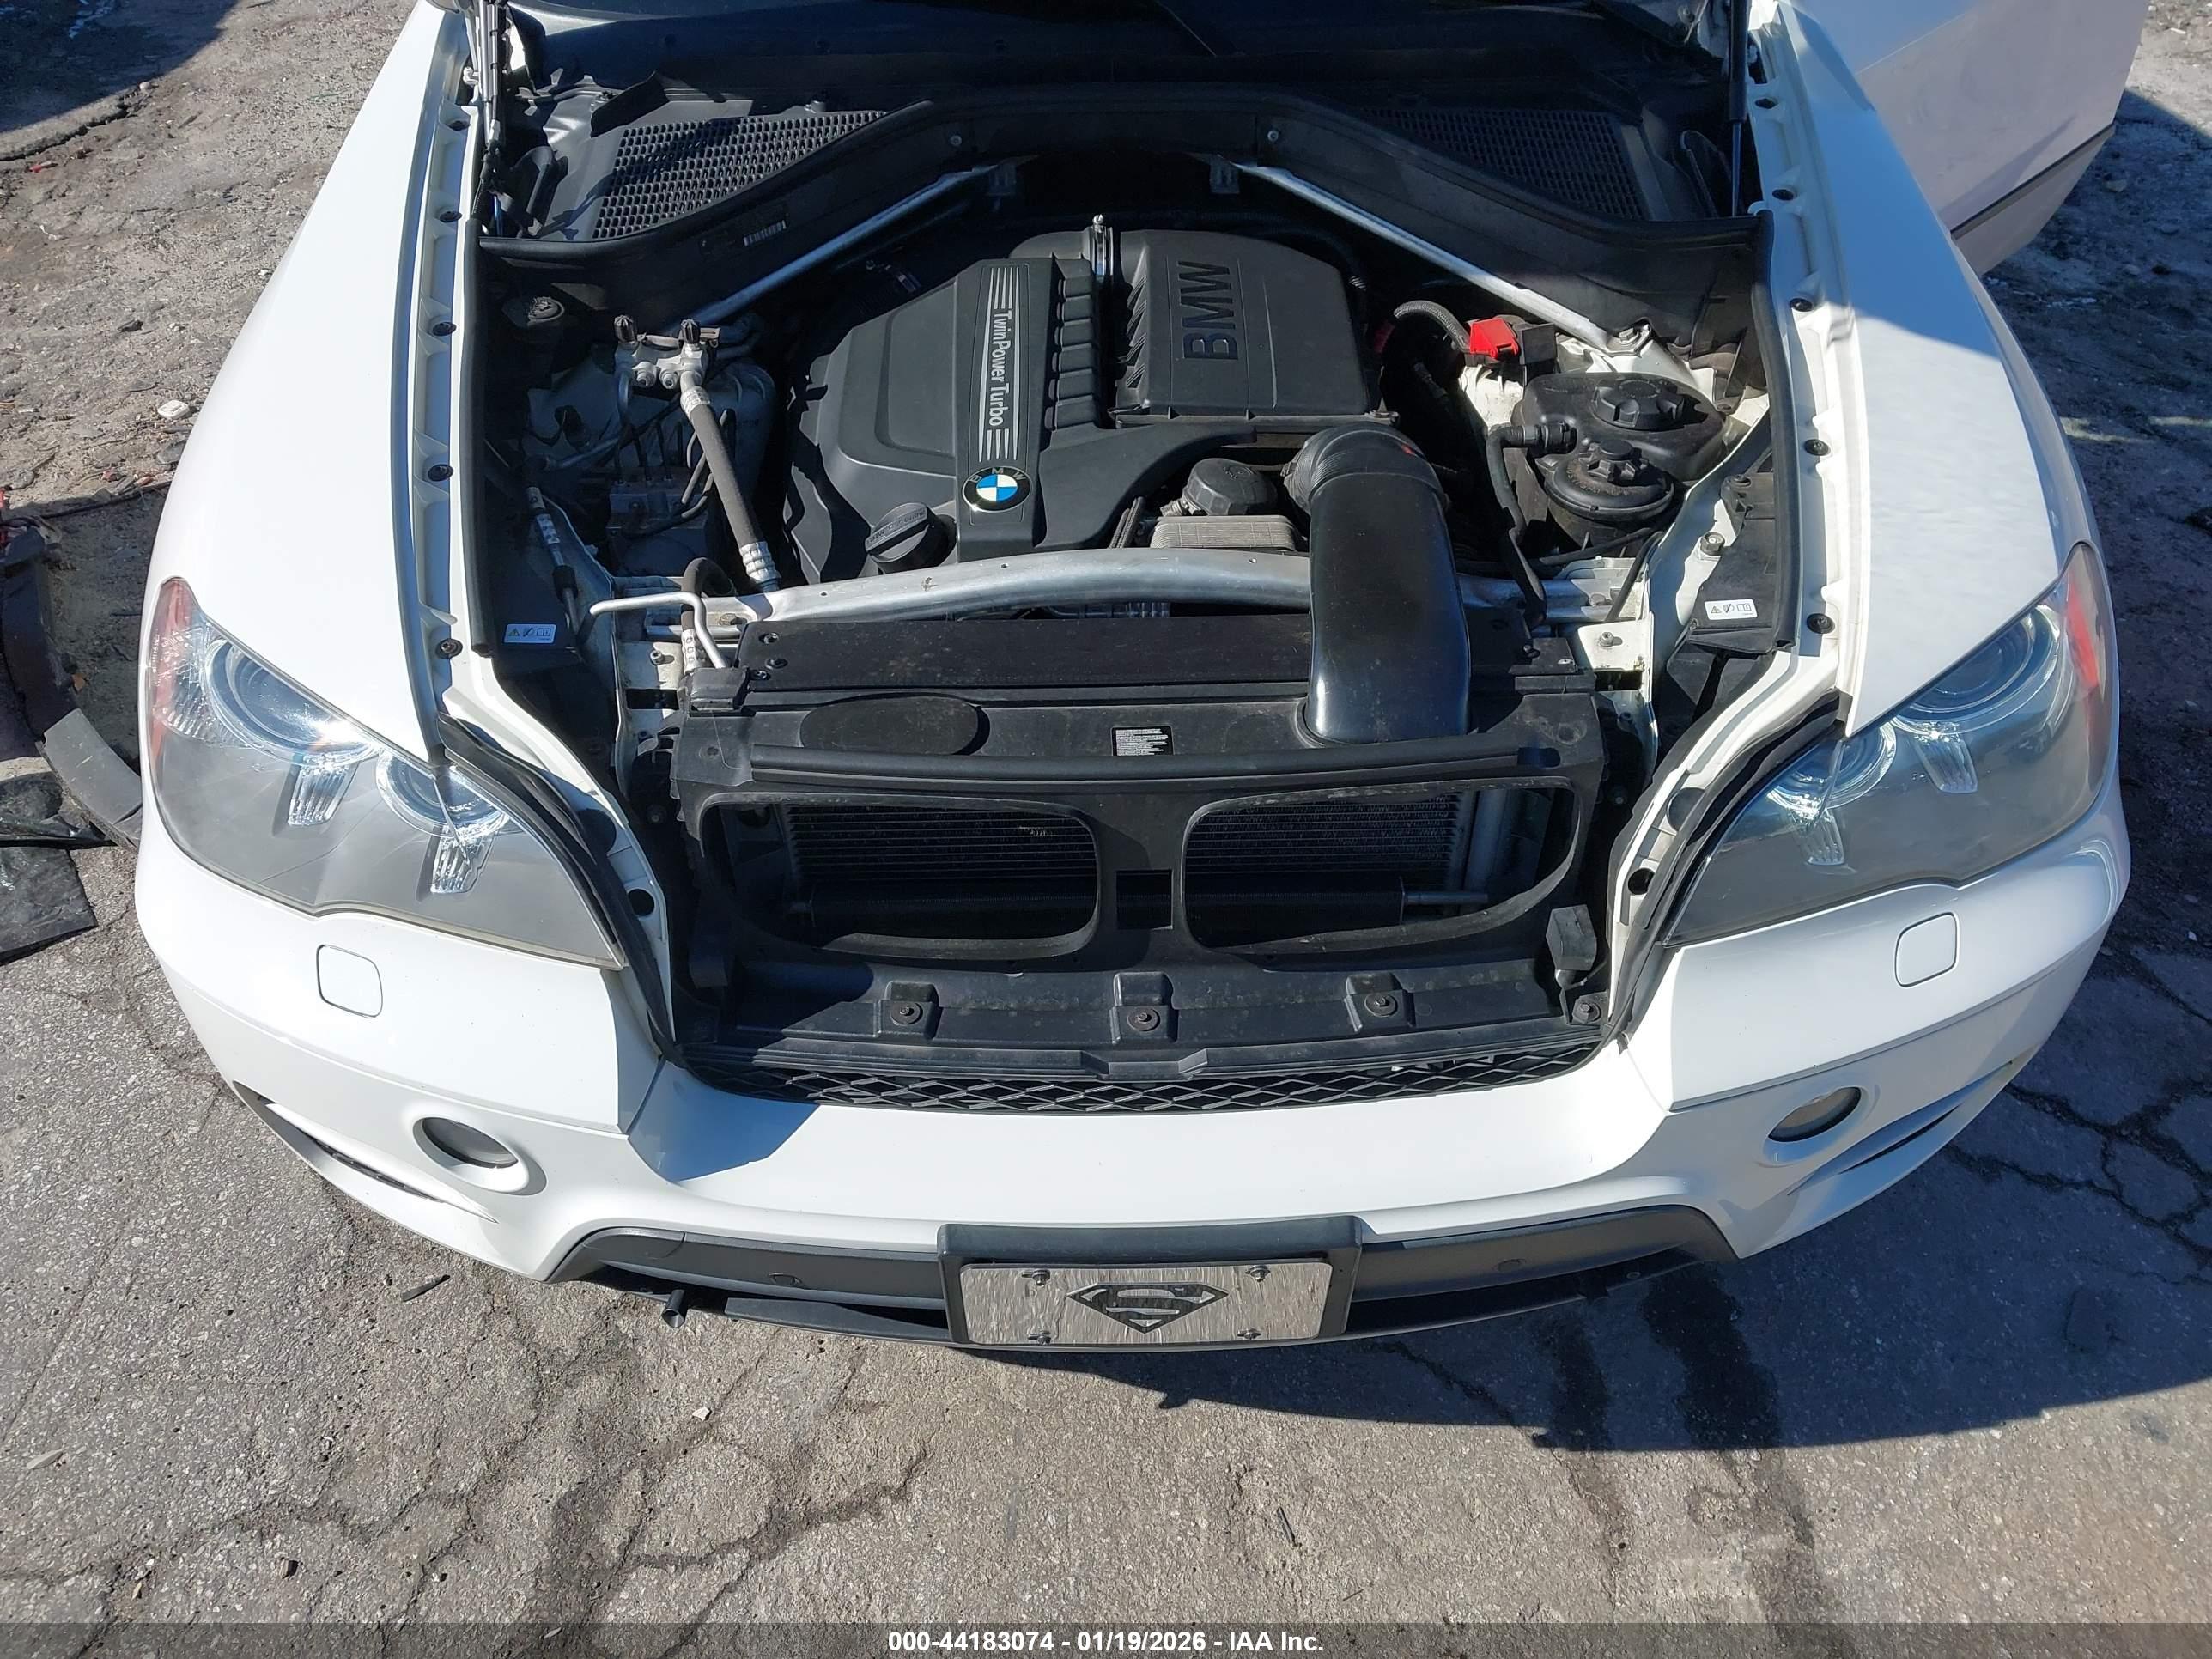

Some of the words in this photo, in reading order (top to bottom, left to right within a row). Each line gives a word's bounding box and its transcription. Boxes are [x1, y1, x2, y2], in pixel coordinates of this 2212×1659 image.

[1177, 261, 1238, 360] BMW
[991, 310, 1012, 382] TwinPower
[988, 383, 1009, 426] Turbo
[969, 467, 1026, 483] BMW
